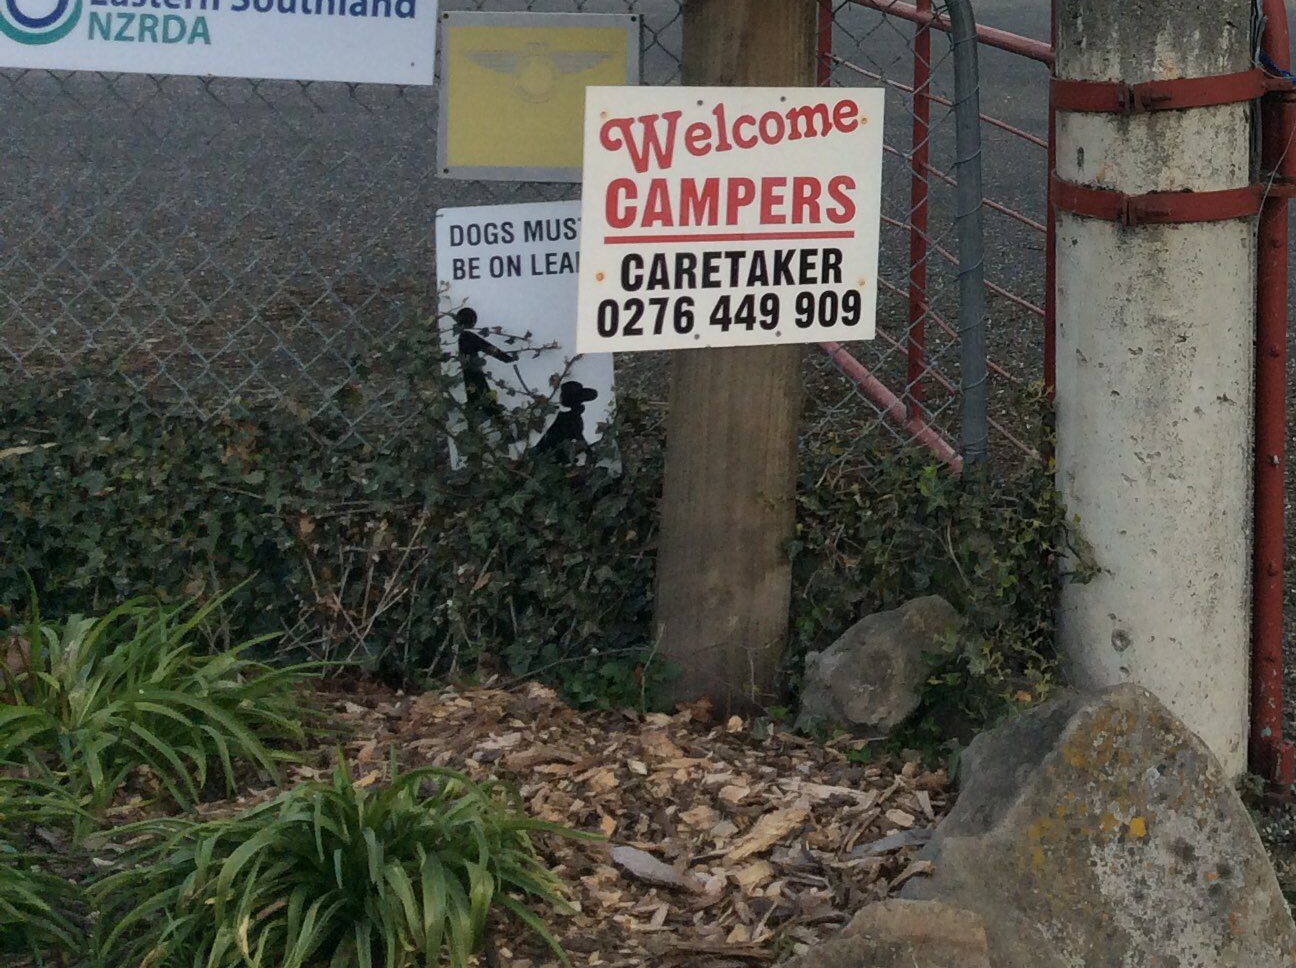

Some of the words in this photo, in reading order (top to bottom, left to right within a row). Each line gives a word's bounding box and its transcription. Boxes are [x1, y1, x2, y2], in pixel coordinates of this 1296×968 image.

[87, 12, 212, 45] NZRDA
[600, 99, 859, 174] Welcome
[605, 175, 856, 229] CAMPERS
[450, 221, 515, 247] DOGS
[524, 216, 582, 243] MUS
[453, 257, 481, 280] BE
[489, 254, 522, 279] ON
[531, 251, 580, 276] LEA
[620, 247, 843, 292] CARETAKER
[596, 295, 695, 338] 0276
[709, 292, 780, 332] 449
[795, 289, 862, 329] 909
